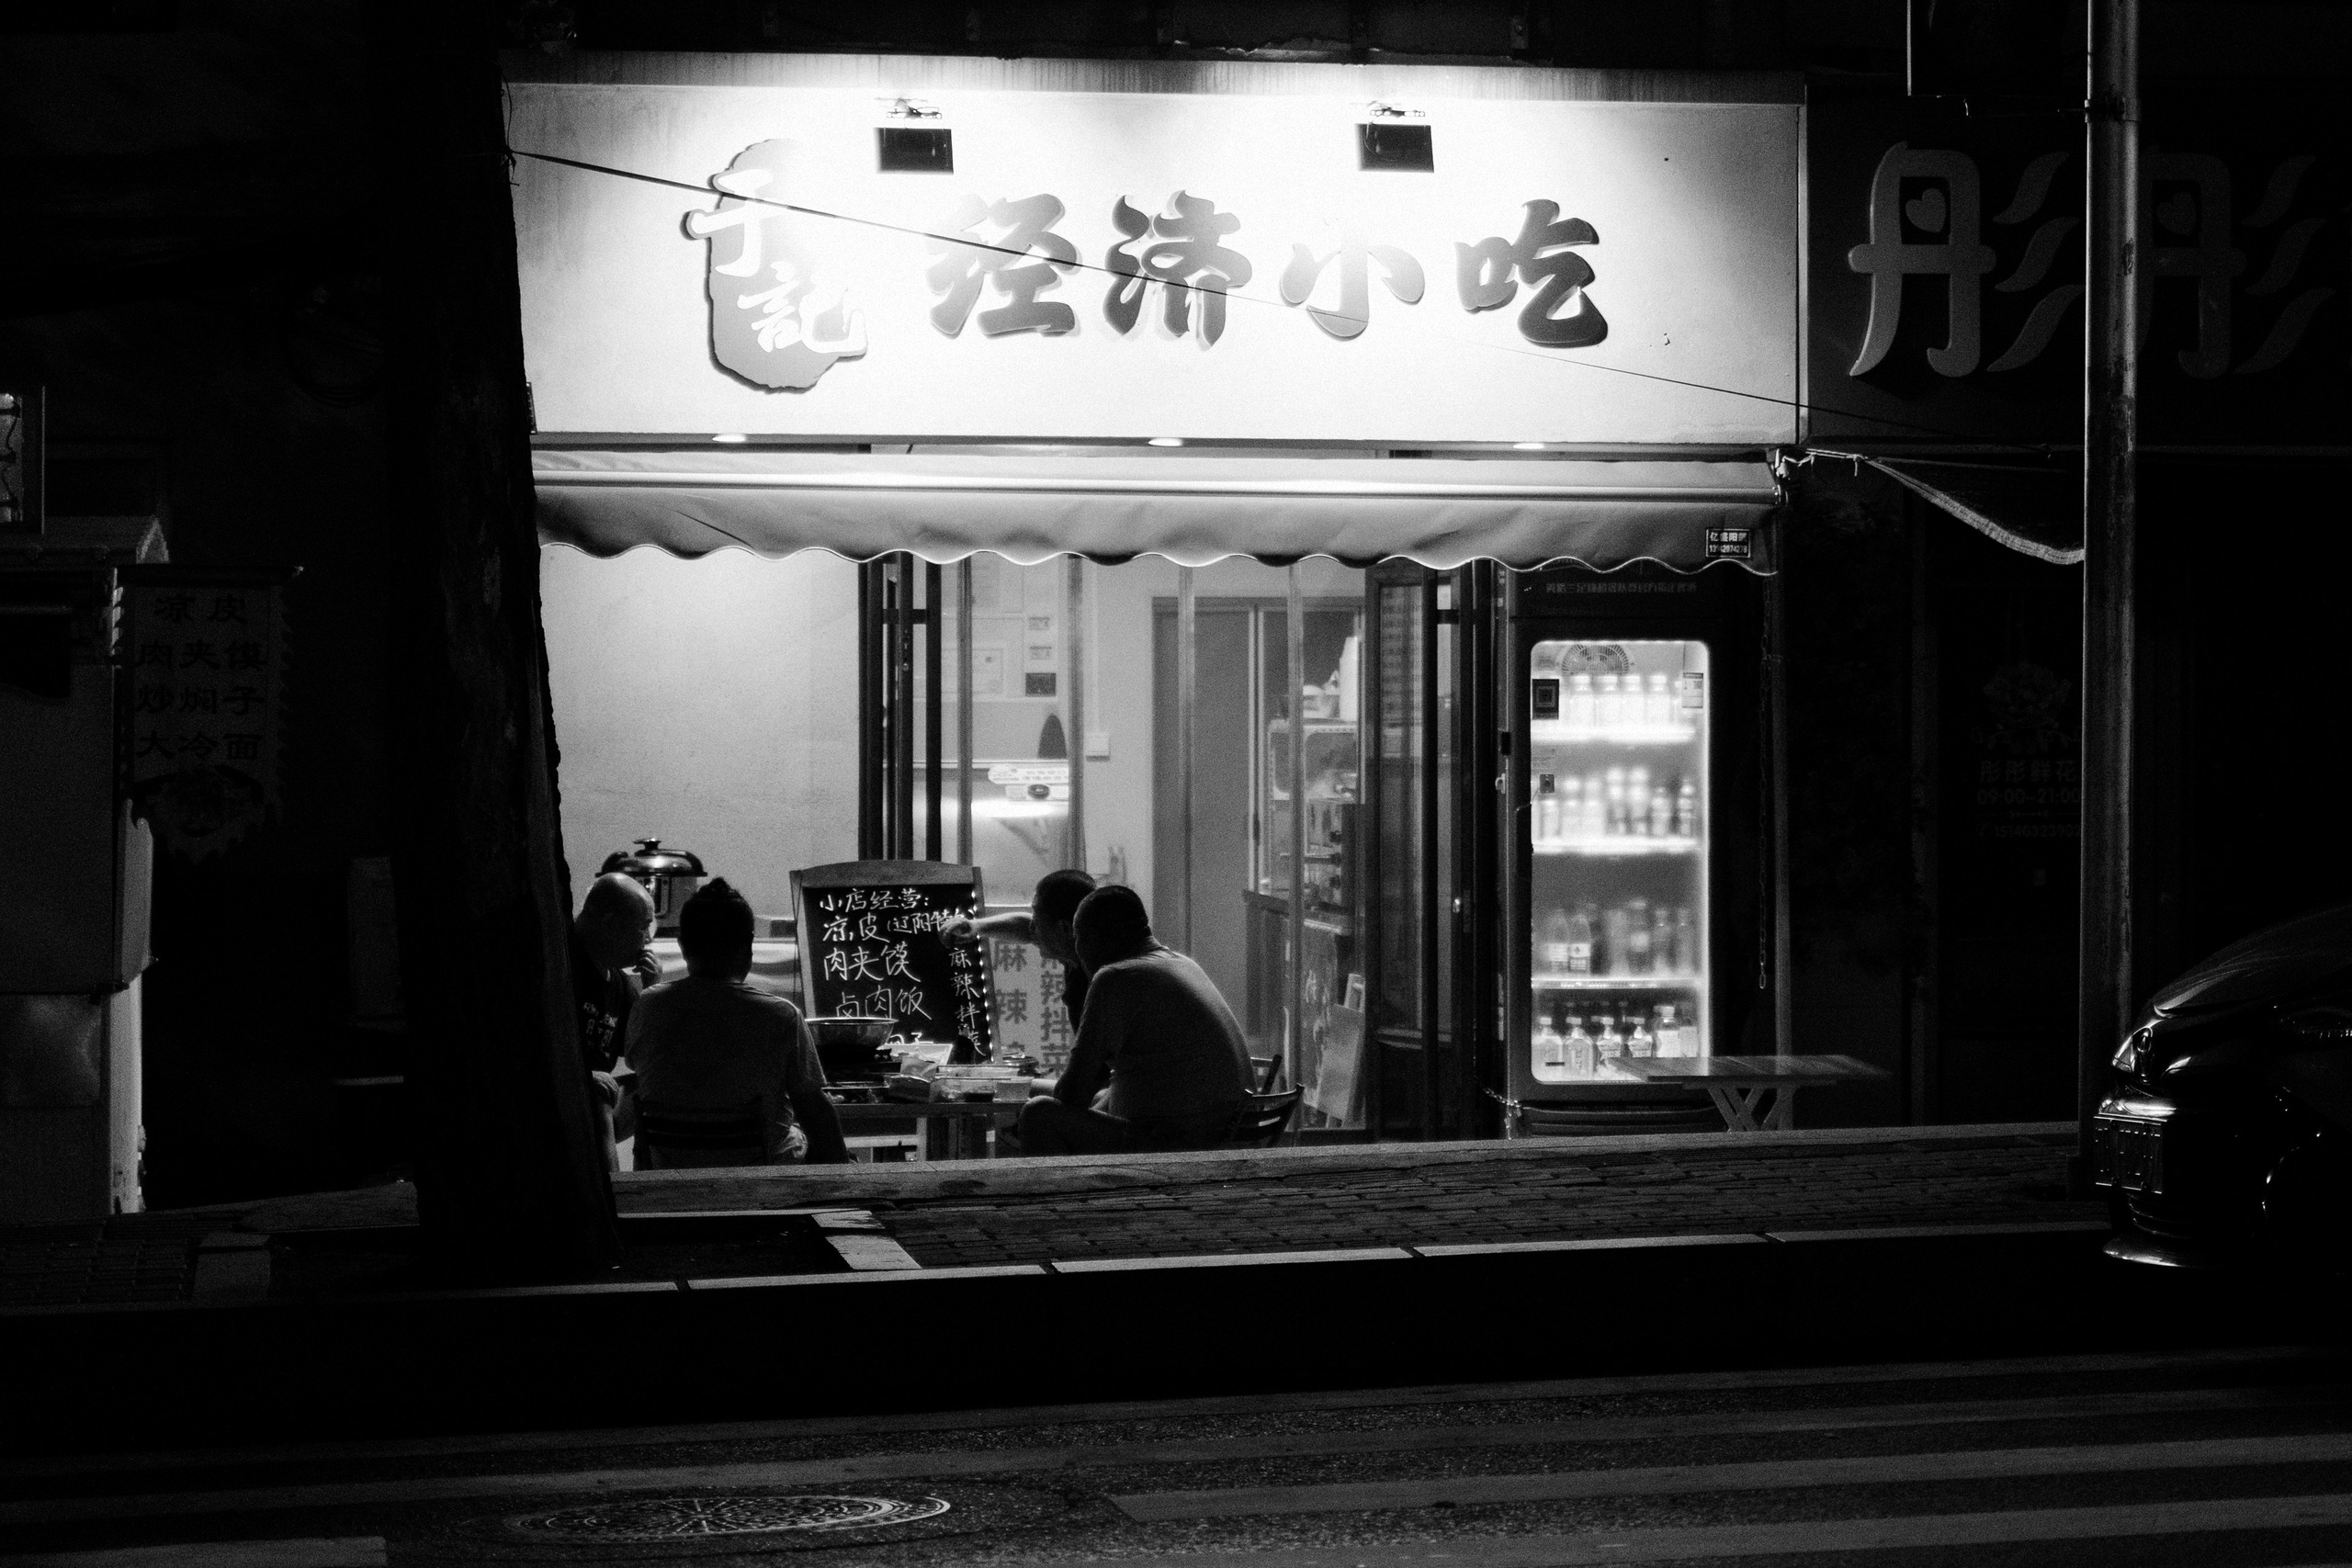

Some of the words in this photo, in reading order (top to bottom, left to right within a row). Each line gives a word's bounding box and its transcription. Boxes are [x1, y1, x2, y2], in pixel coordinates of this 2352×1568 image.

[924, 189, 1609, 348] 经济小吃
[153, 593, 248, 625] 凉皮
[137, 639, 266, 672] 肉夹馍
[136, 730, 264, 761] 大冷面
[824, 941, 921, 982] 肉夹馍
[836, 985, 932, 1020] 卤肉饭
